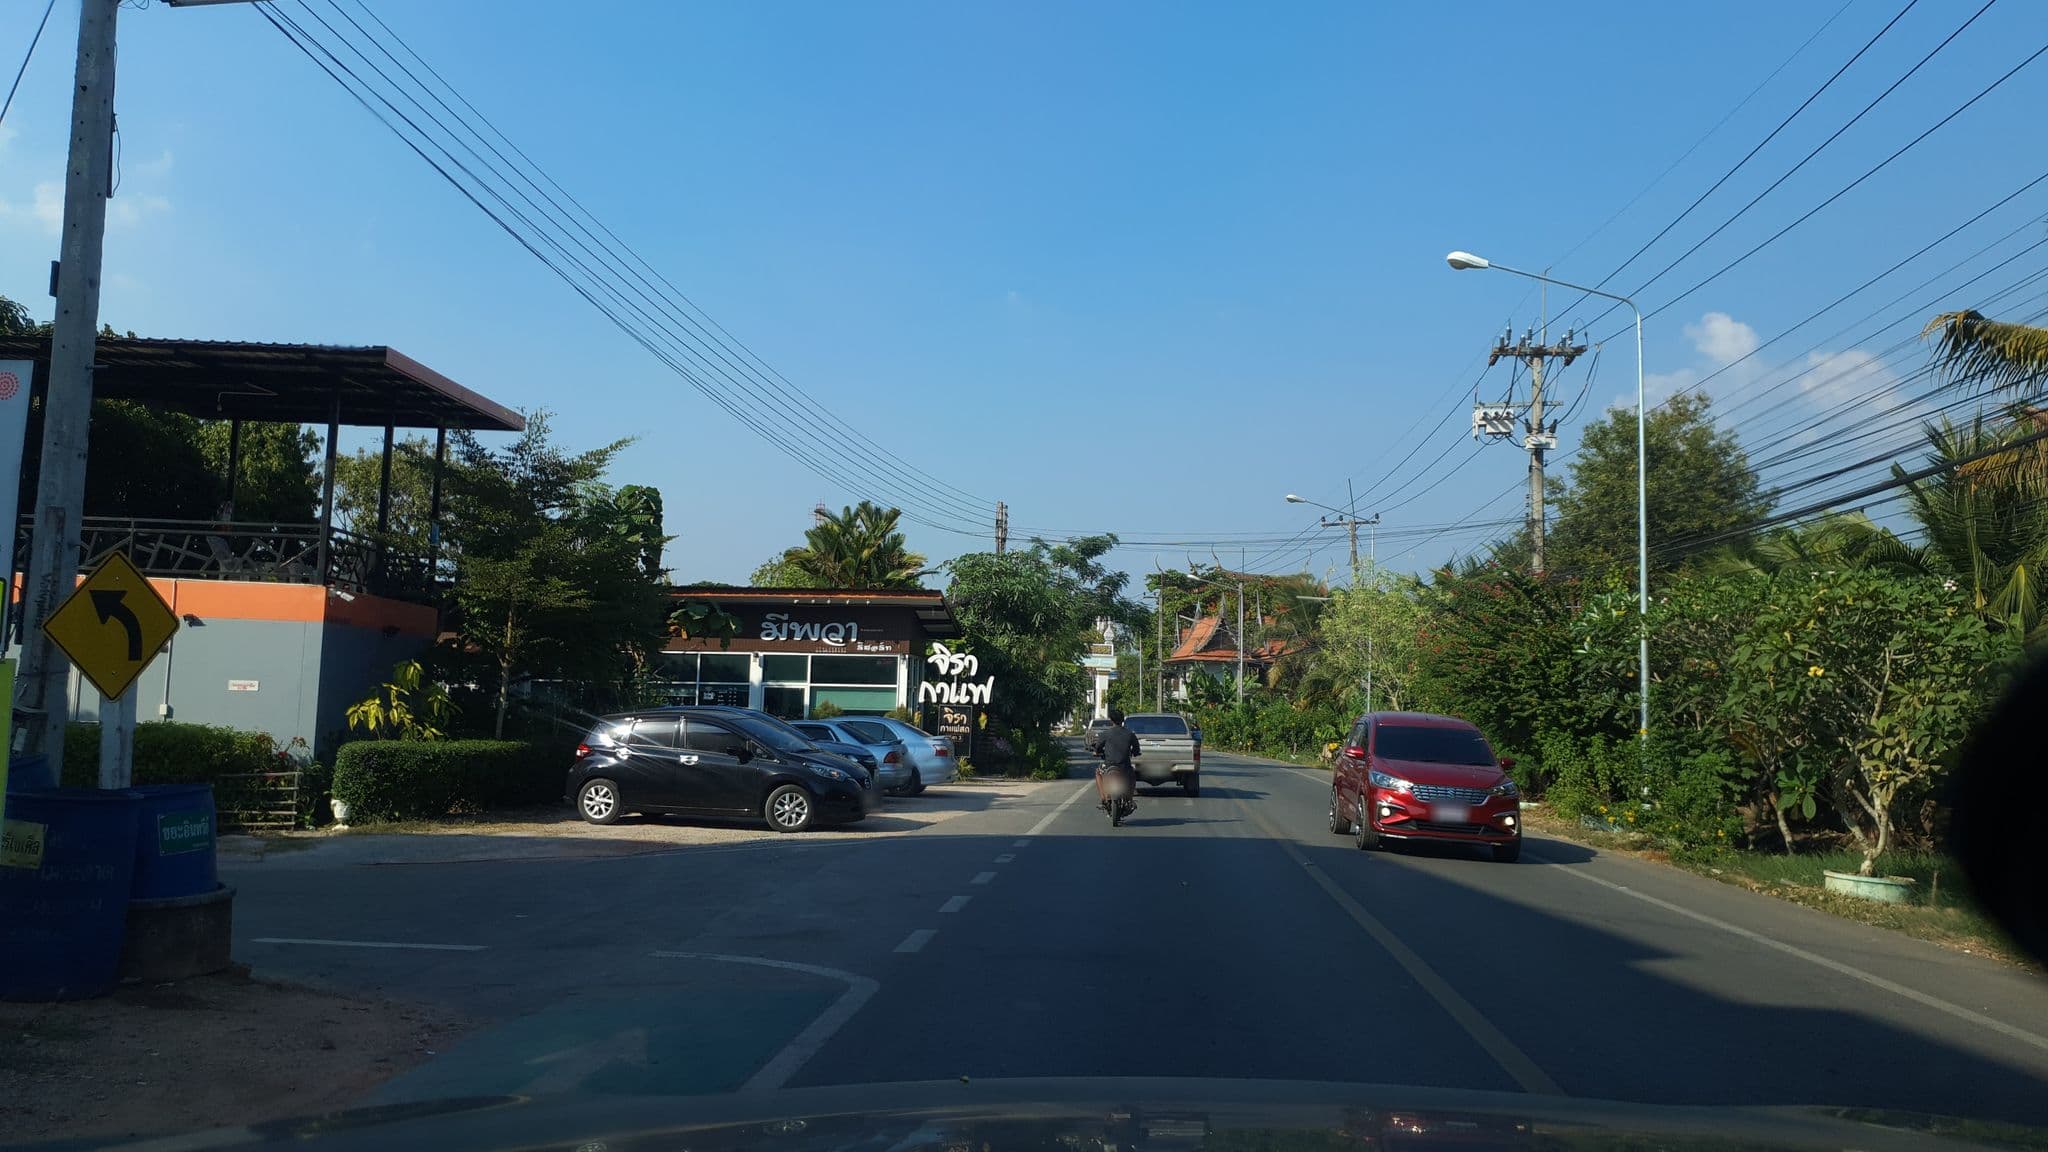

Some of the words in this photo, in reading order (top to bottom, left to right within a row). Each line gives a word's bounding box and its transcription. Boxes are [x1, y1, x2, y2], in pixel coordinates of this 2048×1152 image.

[927, 641, 979, 676] จิรา
[918, 675, 995, 705] กาแฟ
[944, 706, 967, 724] จิรา
[939, 724, 970, 734] กาแฟสด
